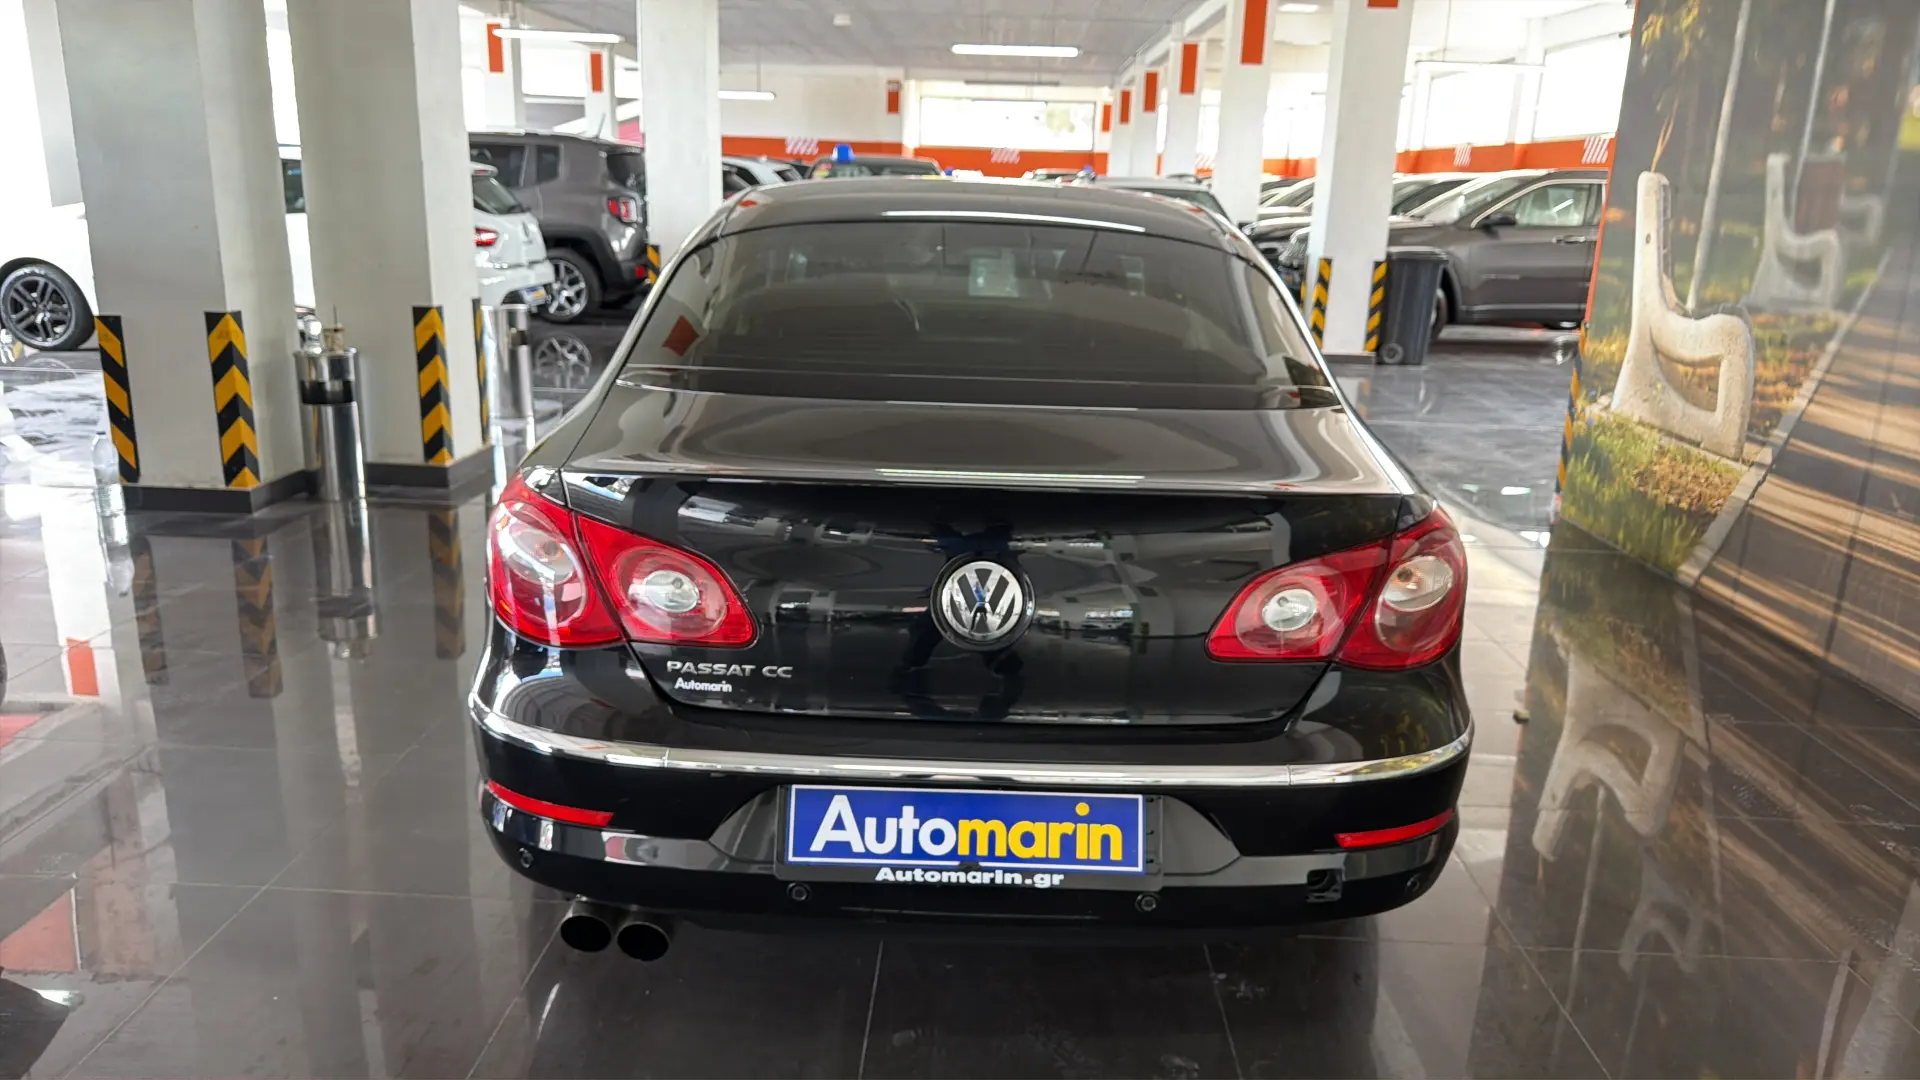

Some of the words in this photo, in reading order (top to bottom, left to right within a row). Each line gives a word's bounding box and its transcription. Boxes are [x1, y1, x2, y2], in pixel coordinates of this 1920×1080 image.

[666, 660, 756, 677] PASSAT
[762, 665, 793, 679] CC
[674, 677, 733, 692] Automarin
[809, 794, 1123, 862] Automarin
[874, 866, 1064, 889] Automarin.gr
